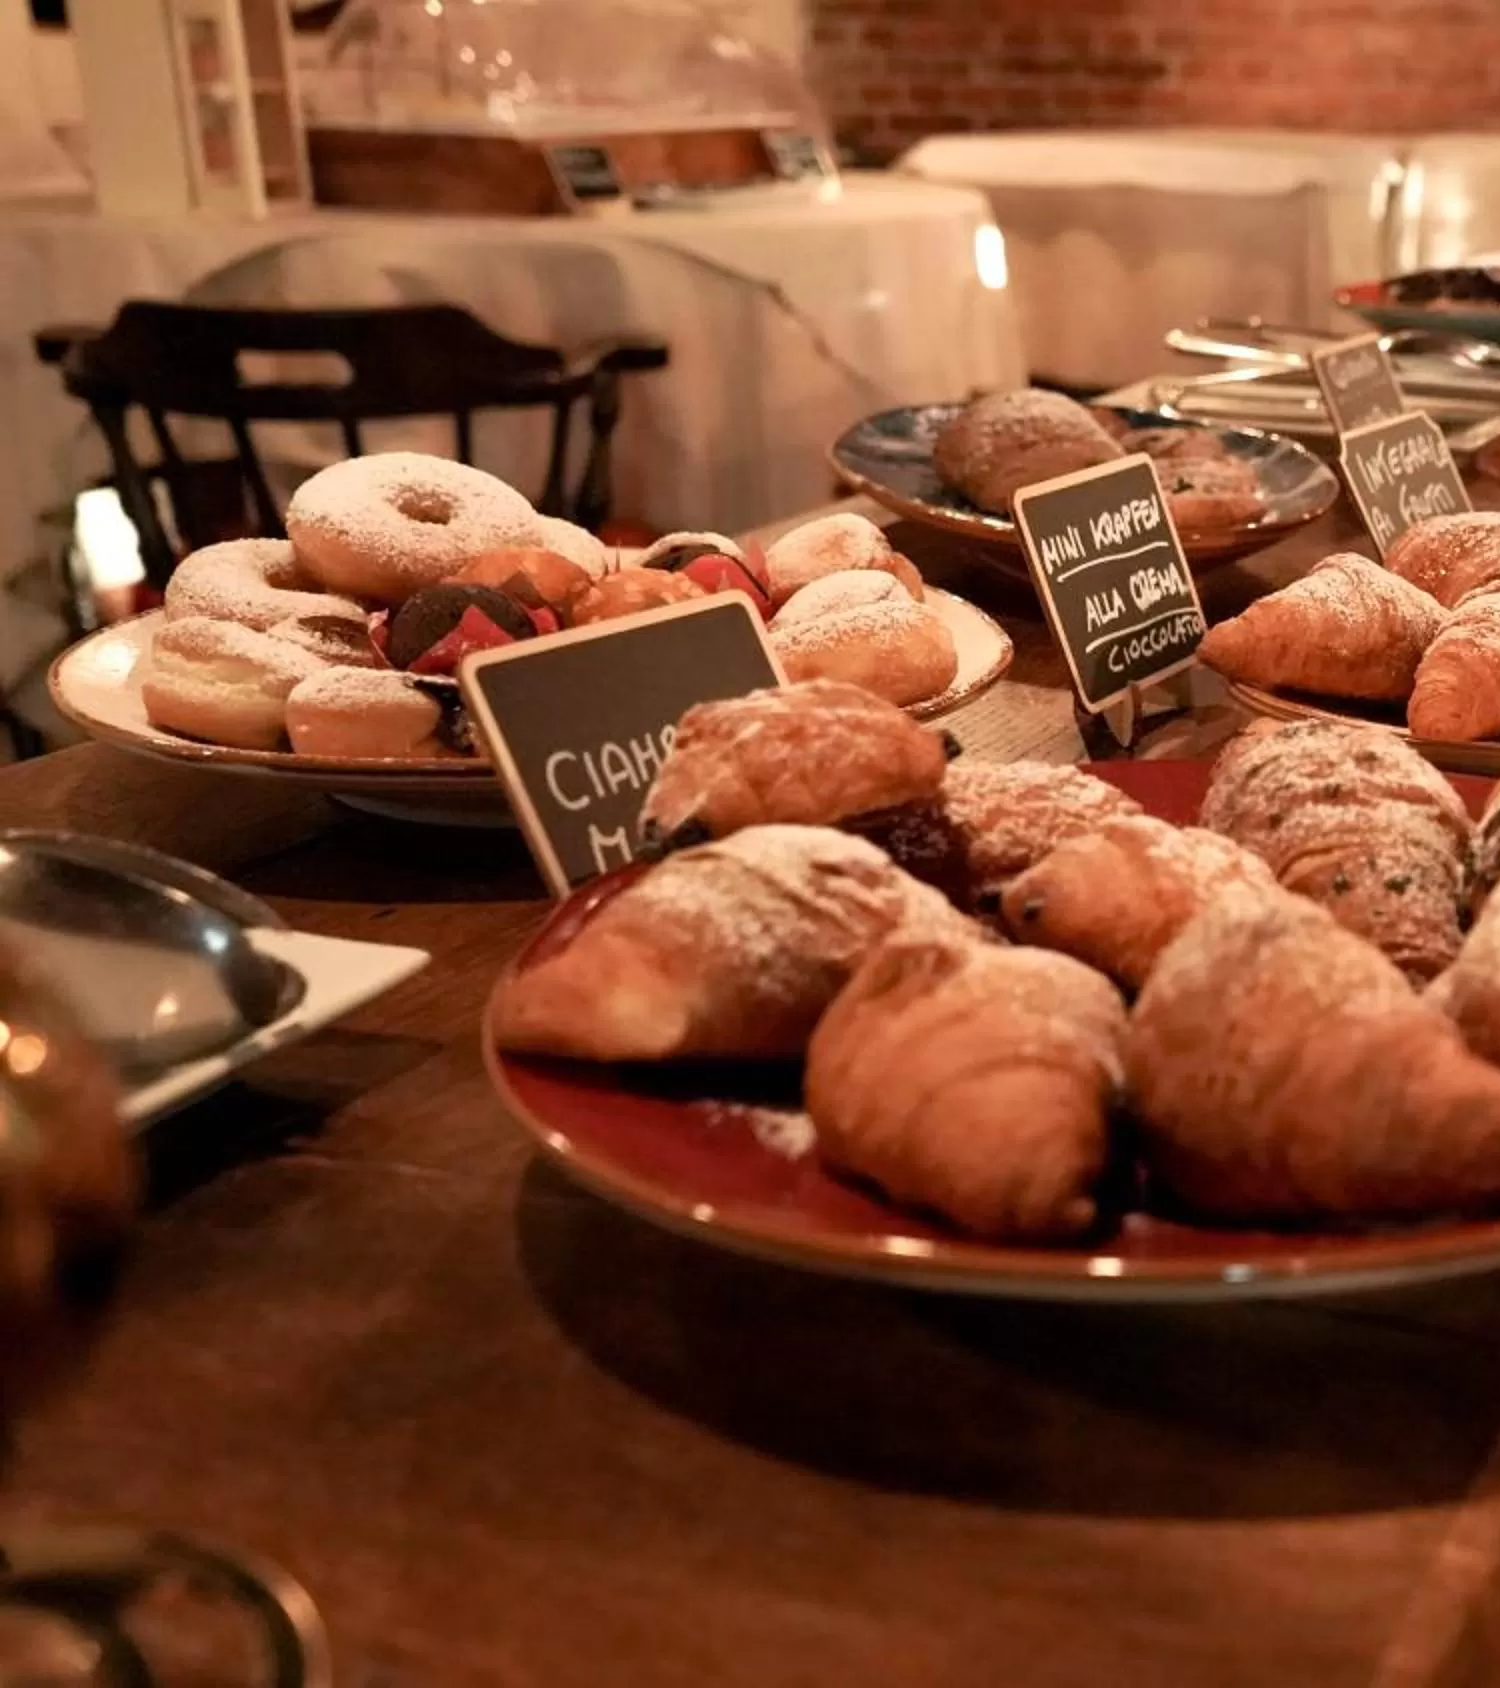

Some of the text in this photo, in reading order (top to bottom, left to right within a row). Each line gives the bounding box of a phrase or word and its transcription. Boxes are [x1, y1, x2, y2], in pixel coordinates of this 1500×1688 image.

[1040, 493, 1161, 575] MINI KRAPFEN
[1085, 561, 1189, 633] ALLA CREMA
[1107, 614, 1202, 673] CIOCCOLATO
